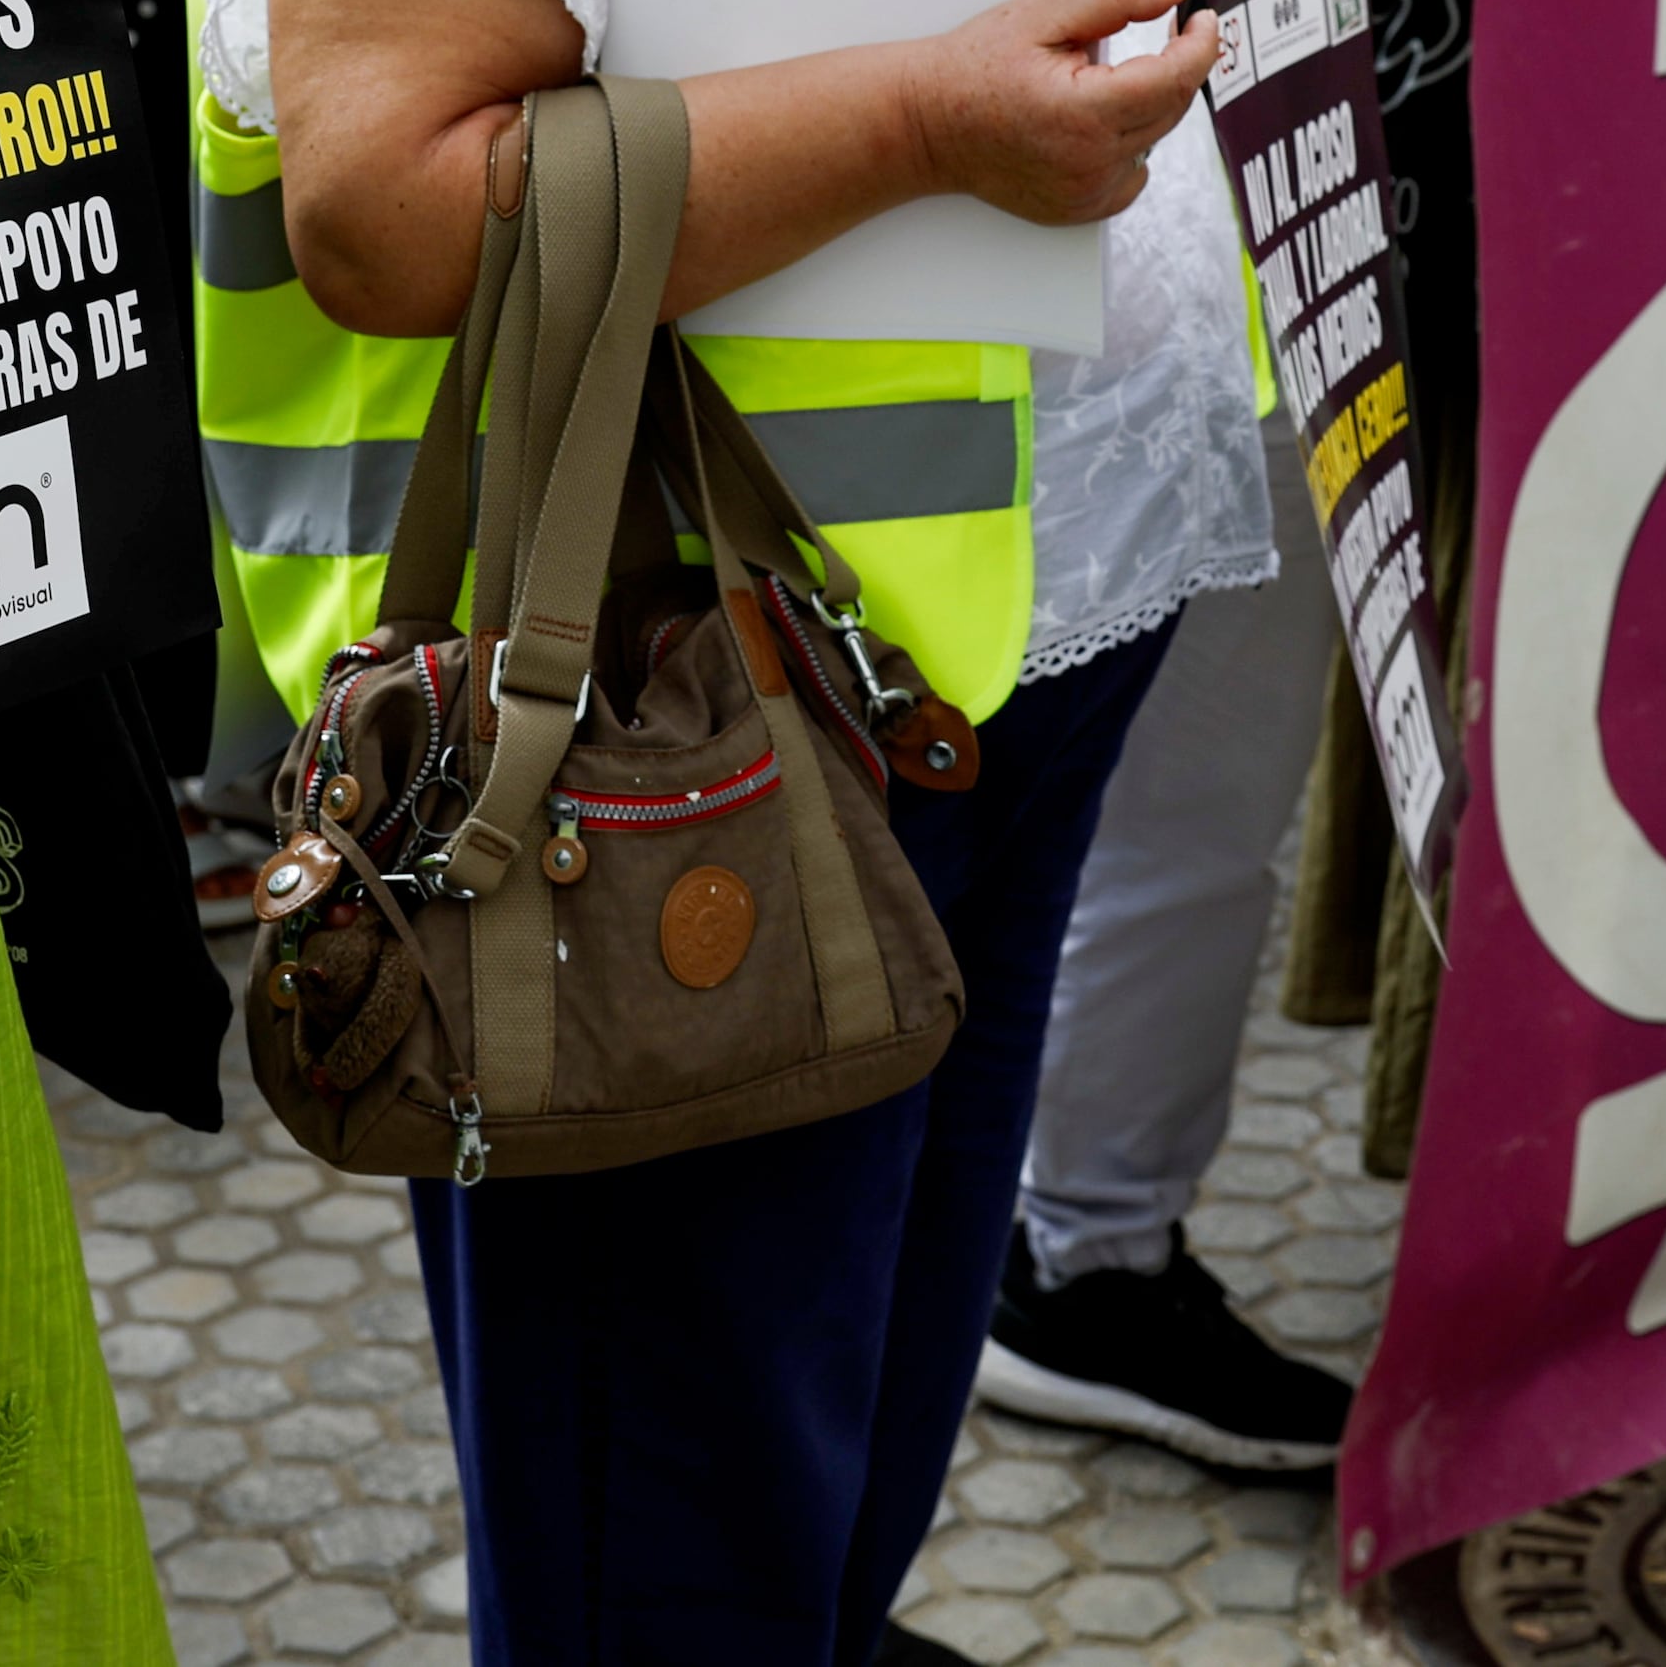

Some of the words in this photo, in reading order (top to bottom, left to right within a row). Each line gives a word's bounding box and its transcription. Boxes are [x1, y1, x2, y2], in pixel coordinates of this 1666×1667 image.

[1242, 152, 1274, 246] NO
[1268, 137, 1298, 227] AL
[1293, 99, 1357, 211] ACOSO
[92, 289, 147, 380] DE
